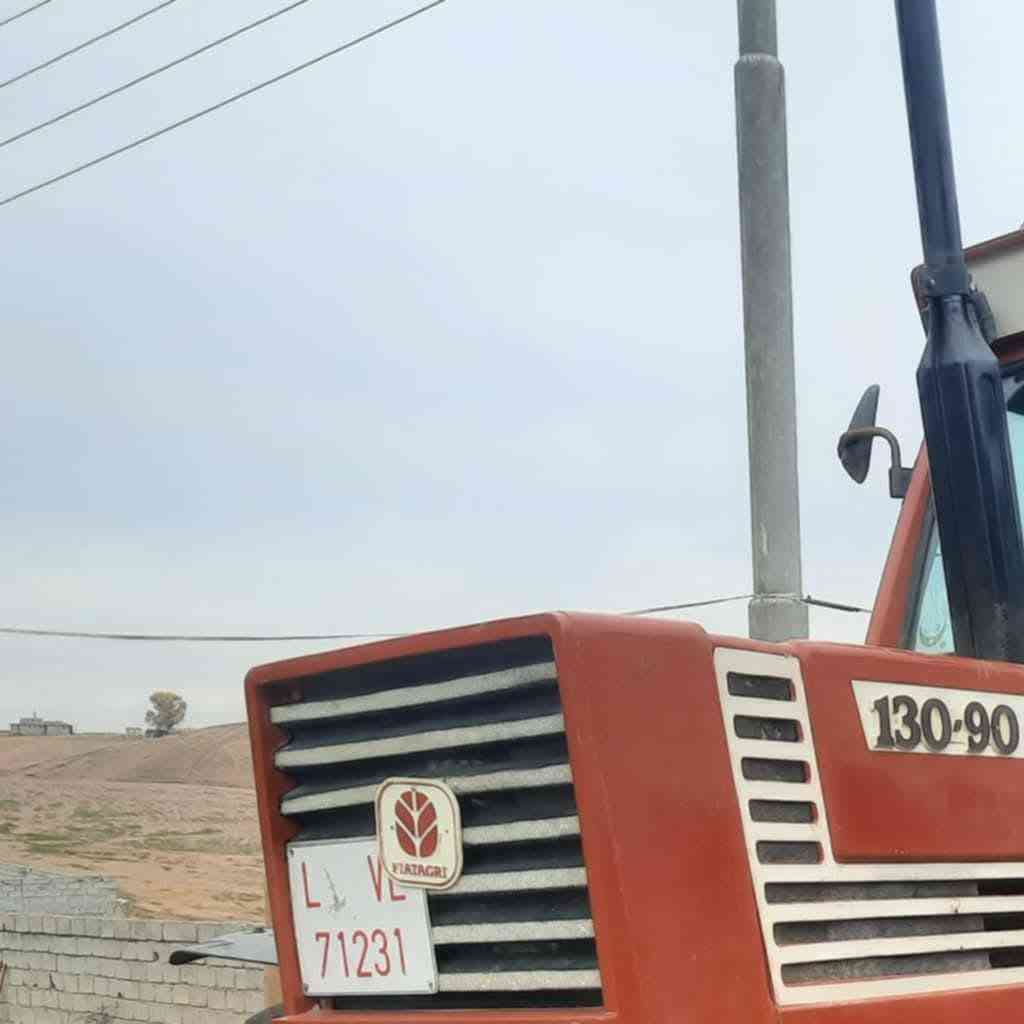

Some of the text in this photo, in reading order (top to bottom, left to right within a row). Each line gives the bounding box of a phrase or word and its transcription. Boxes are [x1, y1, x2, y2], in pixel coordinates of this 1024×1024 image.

[873, 695, 1020, 755] 130-90
[302, 861, 321, 909] L
[315, 928, 406, 979] 71231
